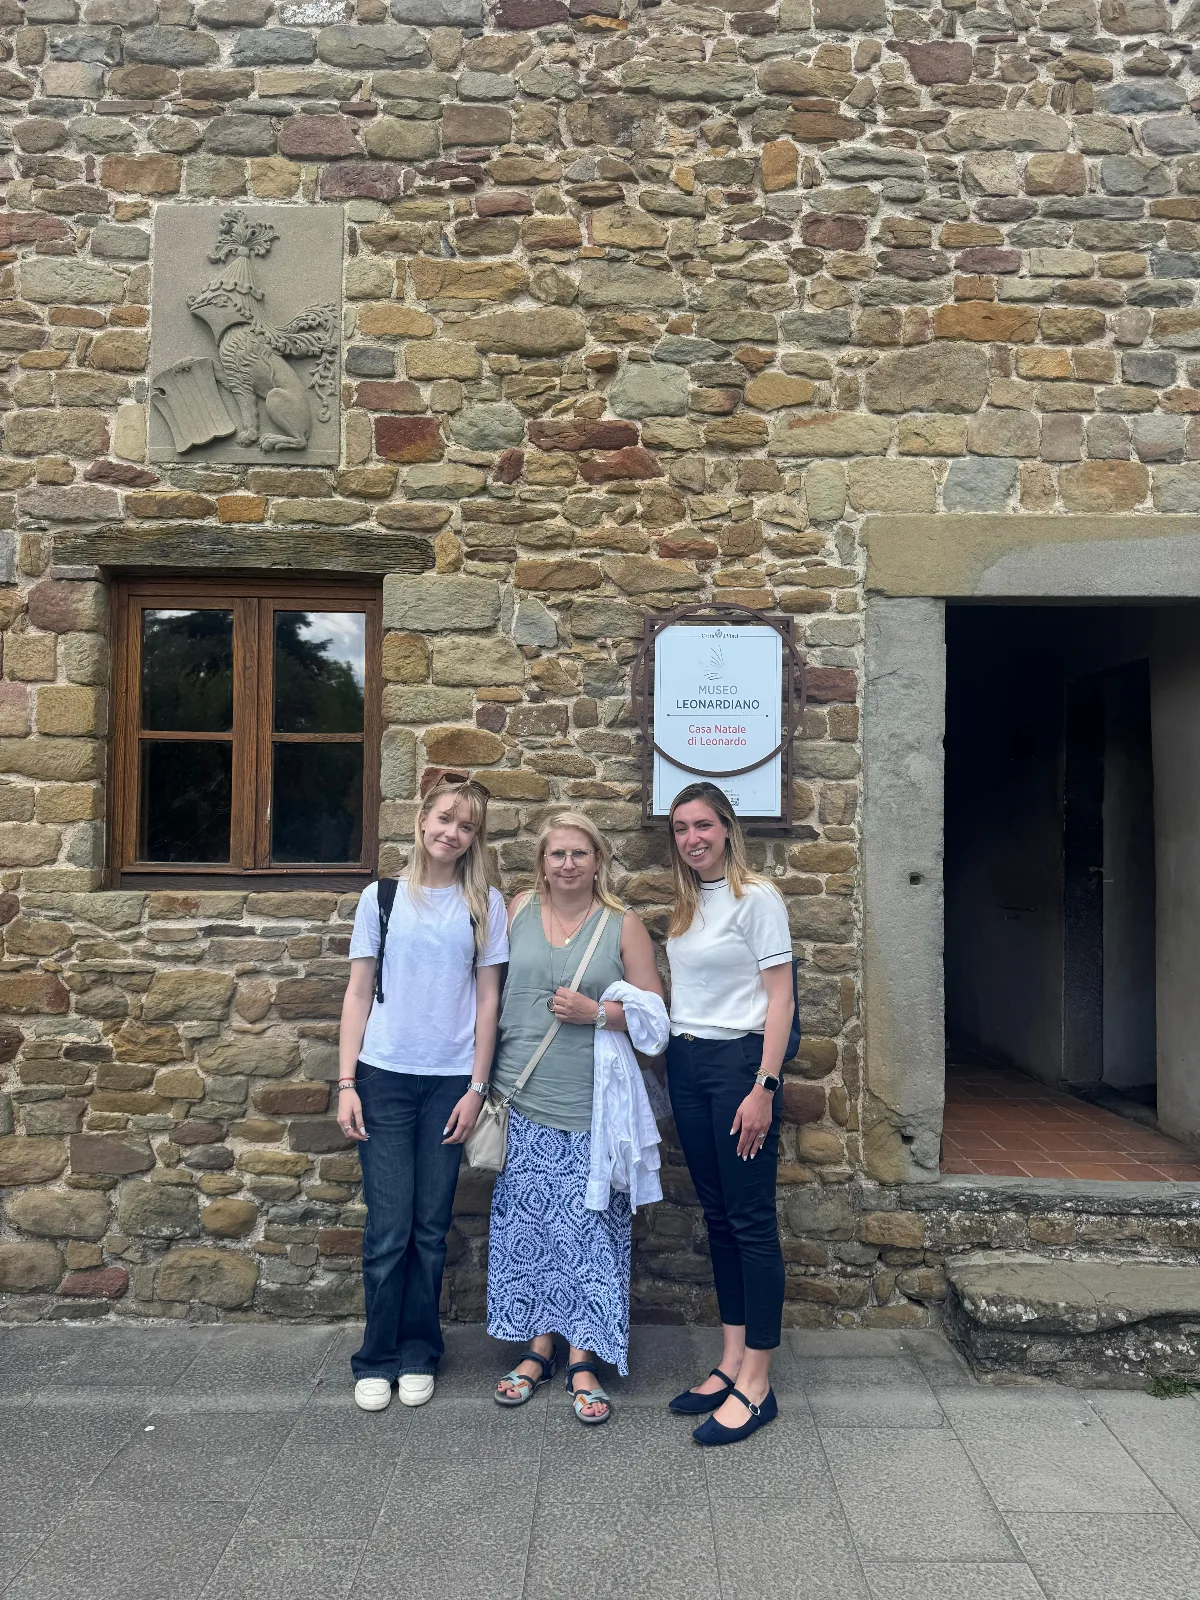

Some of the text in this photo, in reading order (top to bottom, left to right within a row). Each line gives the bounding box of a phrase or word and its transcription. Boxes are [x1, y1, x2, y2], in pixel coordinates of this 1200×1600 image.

[699, 685, 738, 695] MUSEO
[676, 699, 760, 710] LEONARDIANO
[688, 724, 747, 734] Casa Natale
[687, 736, 747, 746] di Leonardo
